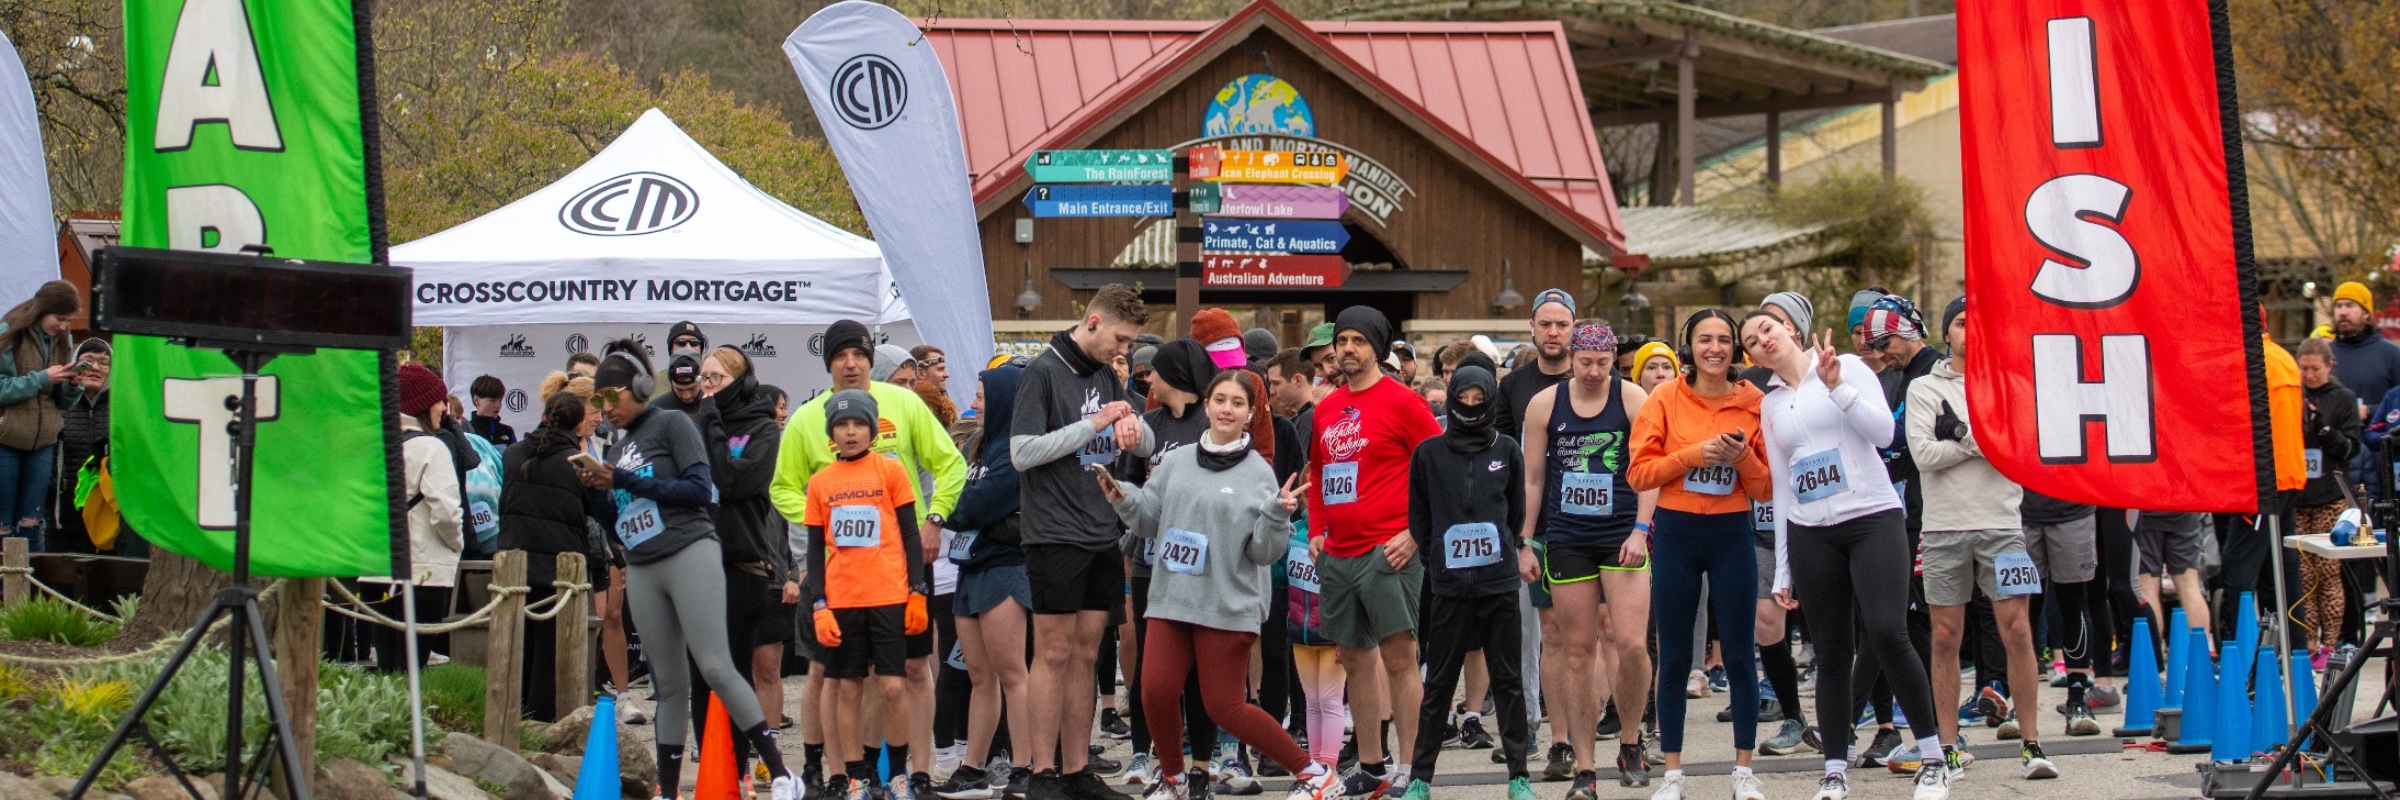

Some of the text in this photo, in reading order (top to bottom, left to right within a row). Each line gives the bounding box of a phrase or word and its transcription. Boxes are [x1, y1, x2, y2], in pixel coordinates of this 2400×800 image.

[1085, 167, 1168, 180] The RainForest
[1245, 167, 1289, 180] Elephant
[1291, 168, 1335, 181] Crossing
[1345, 154, 1406, 202] MANDEL
[1059, 202, 1168, 214] Main Entrance/Exit
[1270, 204, 1294, 216] Lake
[1204, 235, 1336, 251] Primate, Cat & Aquatics
[1208, 272, 1324, 285] Australian Adventure
[416, 280, 638, 304] CROSSCOUNTRY
[1687, 465, 1734, 486] 2643
[1796, 464, 1841, 494] 2644
[828, 489, 884, 503] ARMOUR
[1324, 476, 1353, 496] 2426
[1564, 486, 1608, 506] 2605
[620, 509, 655, 540] 2415
[834, 519, 875, 538] 2607
[1162, 541, 1200, 567] 2427
[1451, 537, 1493, 559] 2715
[1999, 566, 2038, 587] 2350
